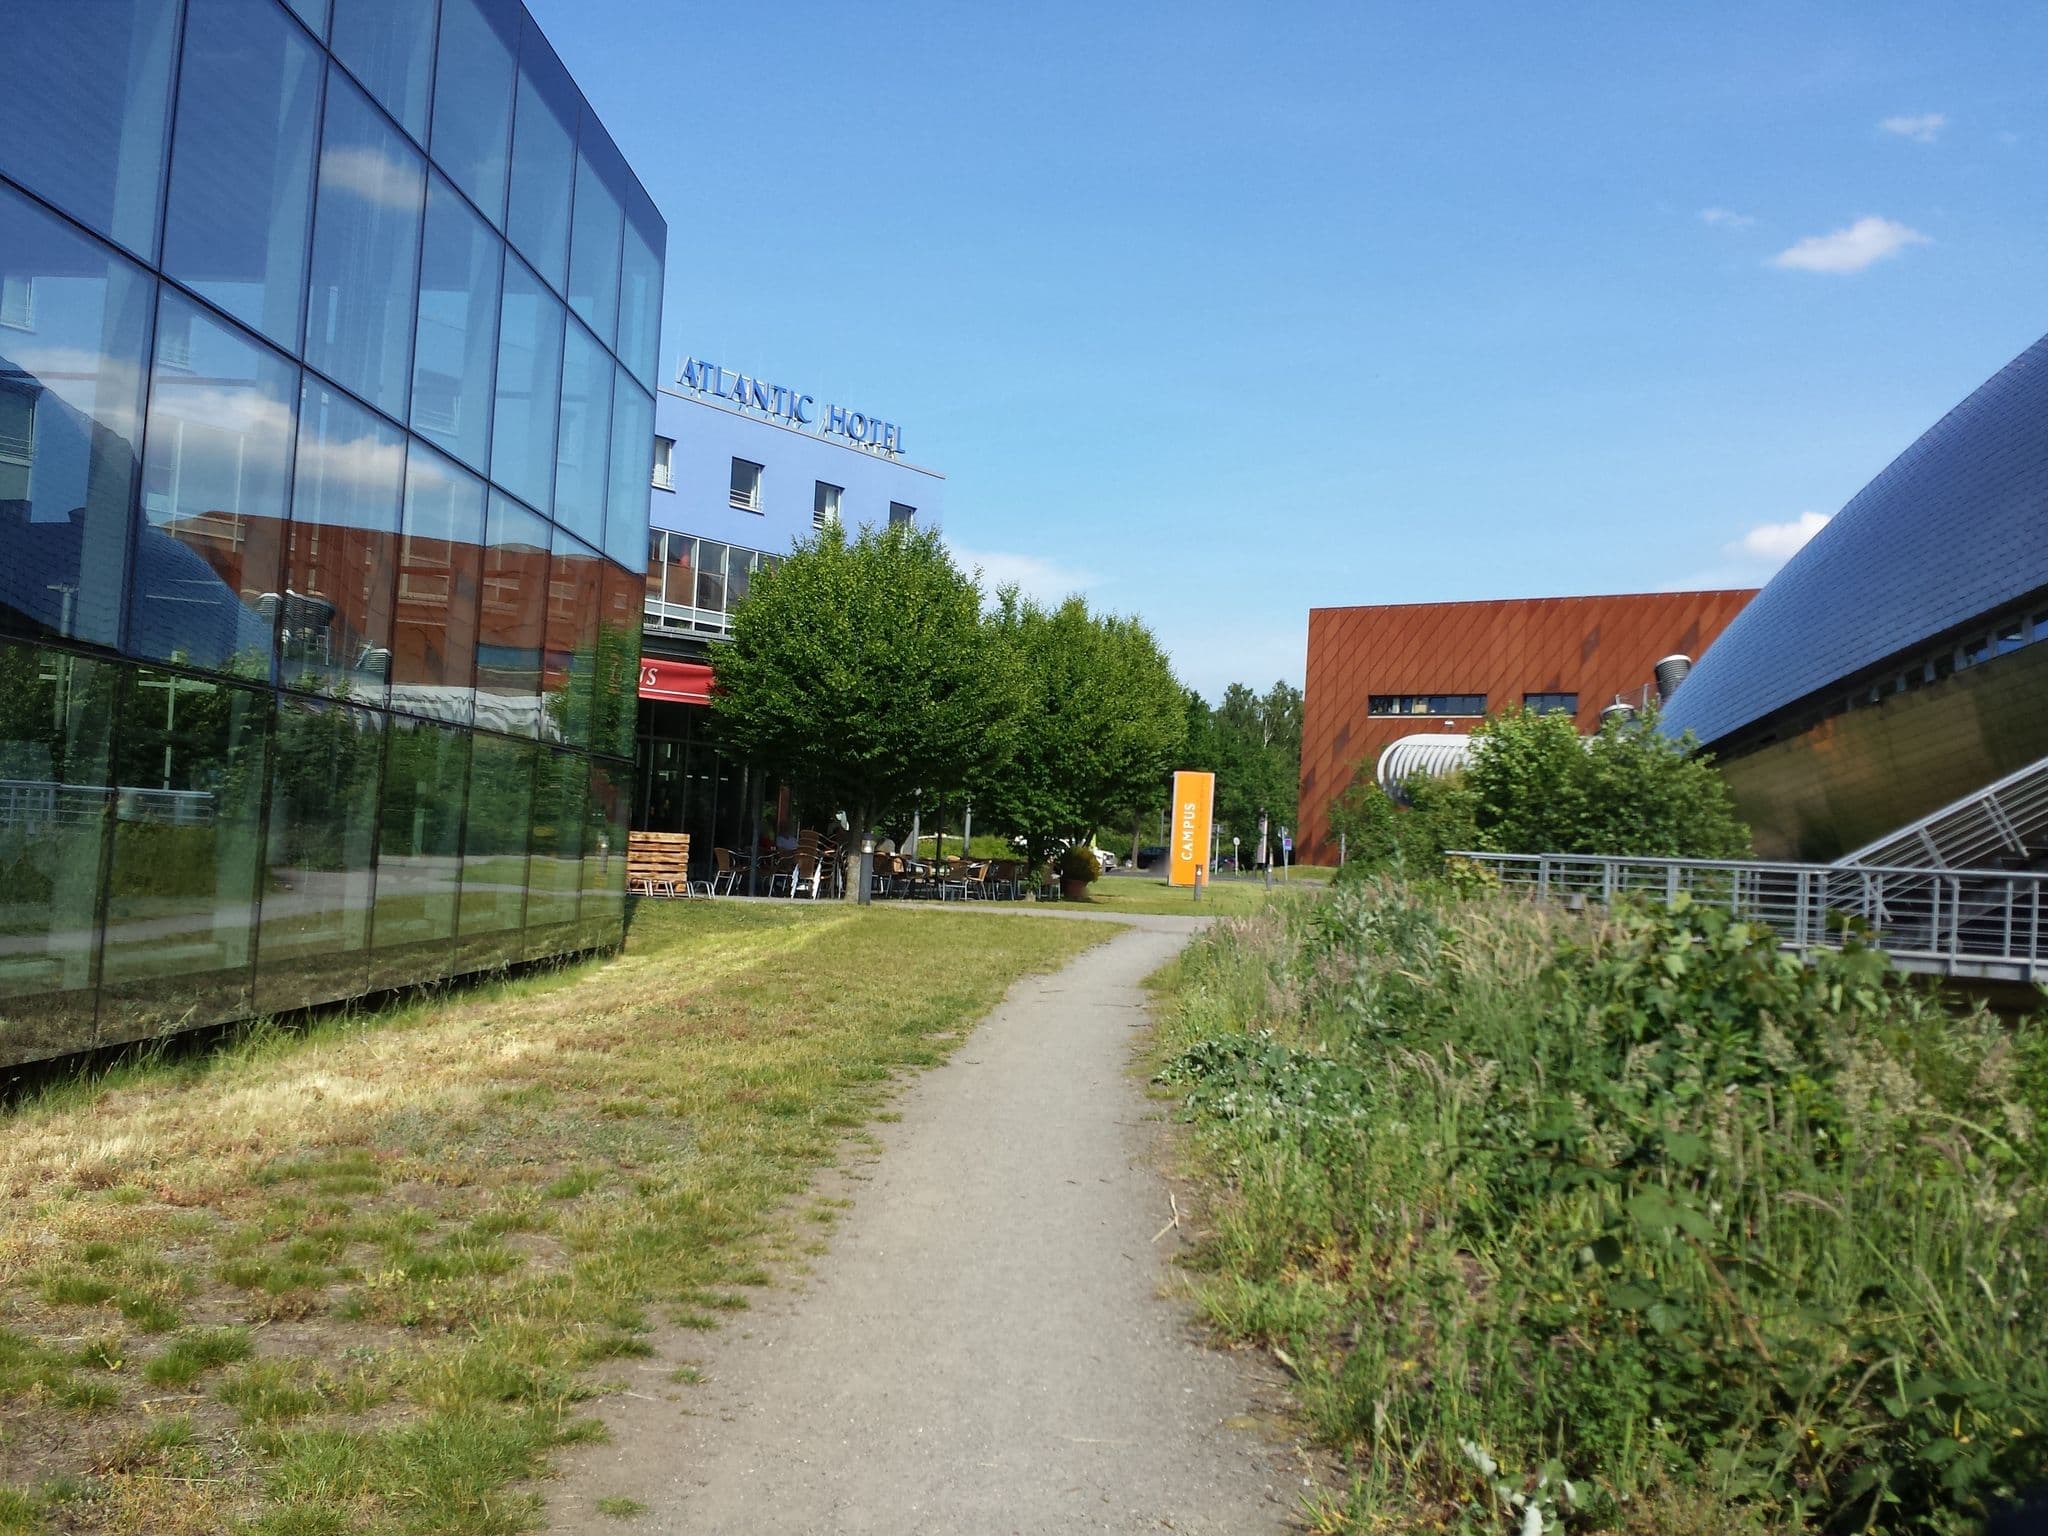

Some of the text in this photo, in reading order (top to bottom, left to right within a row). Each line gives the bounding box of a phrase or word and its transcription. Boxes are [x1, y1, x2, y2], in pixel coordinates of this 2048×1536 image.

[676, 357, 905, 454] ATLANTIC HOTEL
[1181, 803, 1196, 861] CAMPUS
